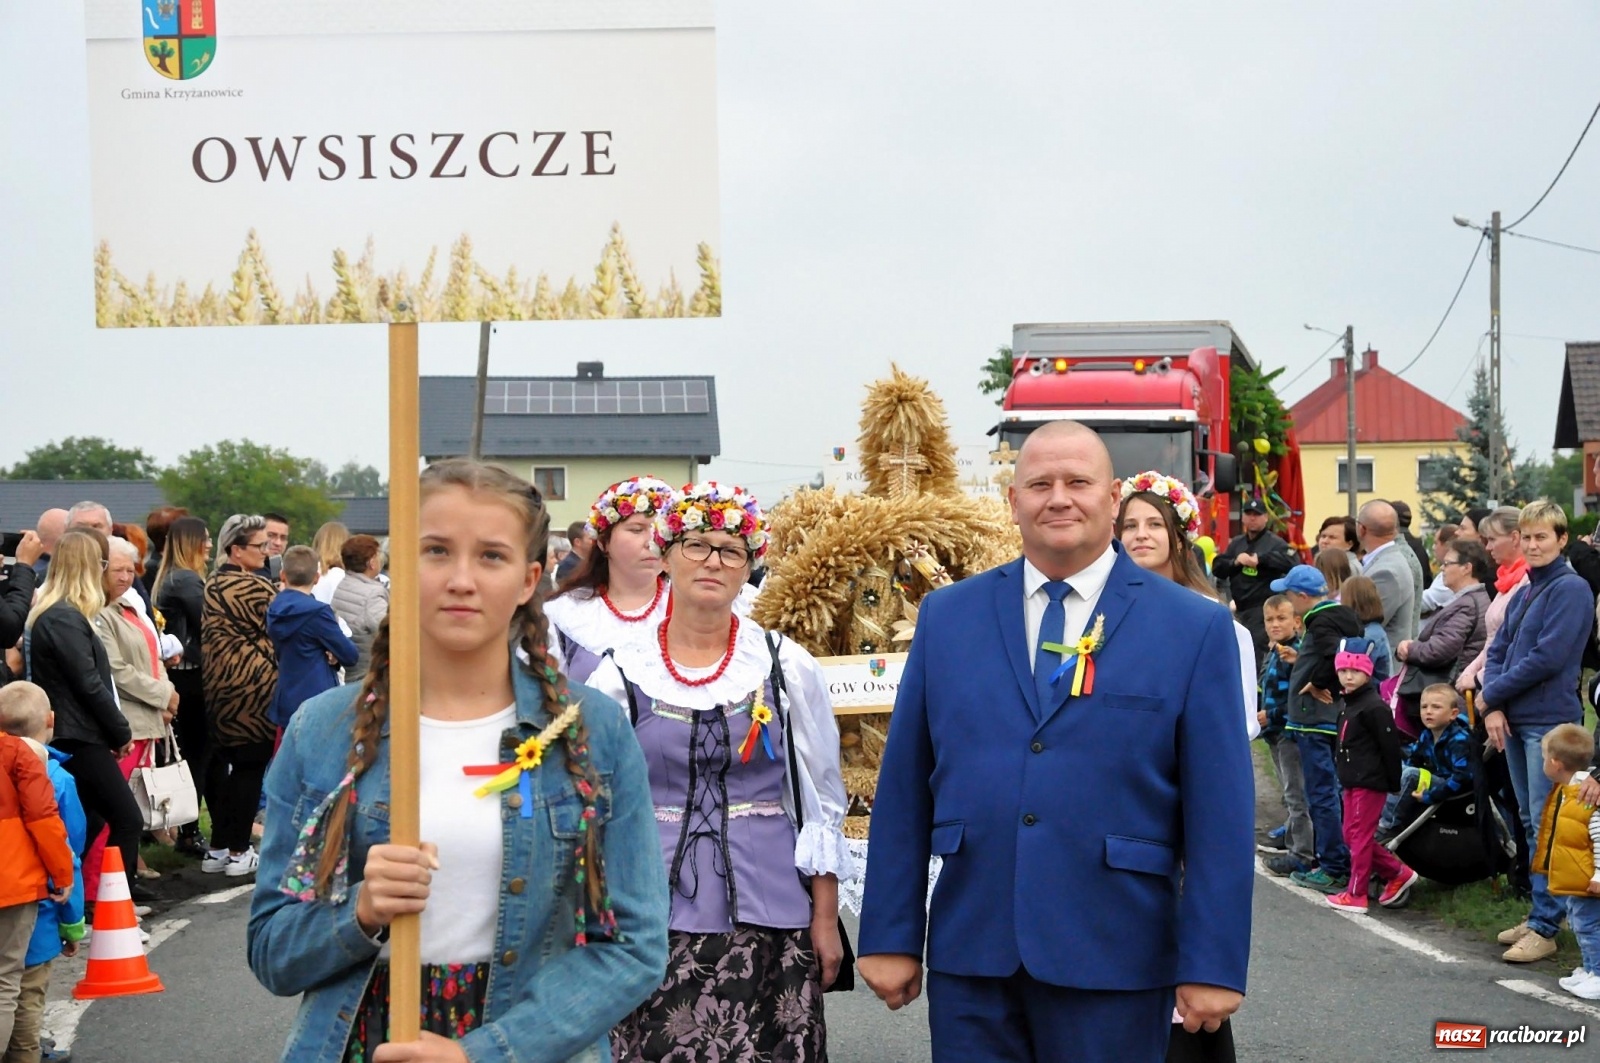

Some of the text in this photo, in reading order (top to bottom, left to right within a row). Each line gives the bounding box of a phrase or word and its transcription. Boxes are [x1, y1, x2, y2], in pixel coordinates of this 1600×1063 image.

[120, 87, 244, 101] Gmina Krzyżanowice
[191, 130, 618, 183] OWSISZCZE
[826, 682, 857, 694] GW
